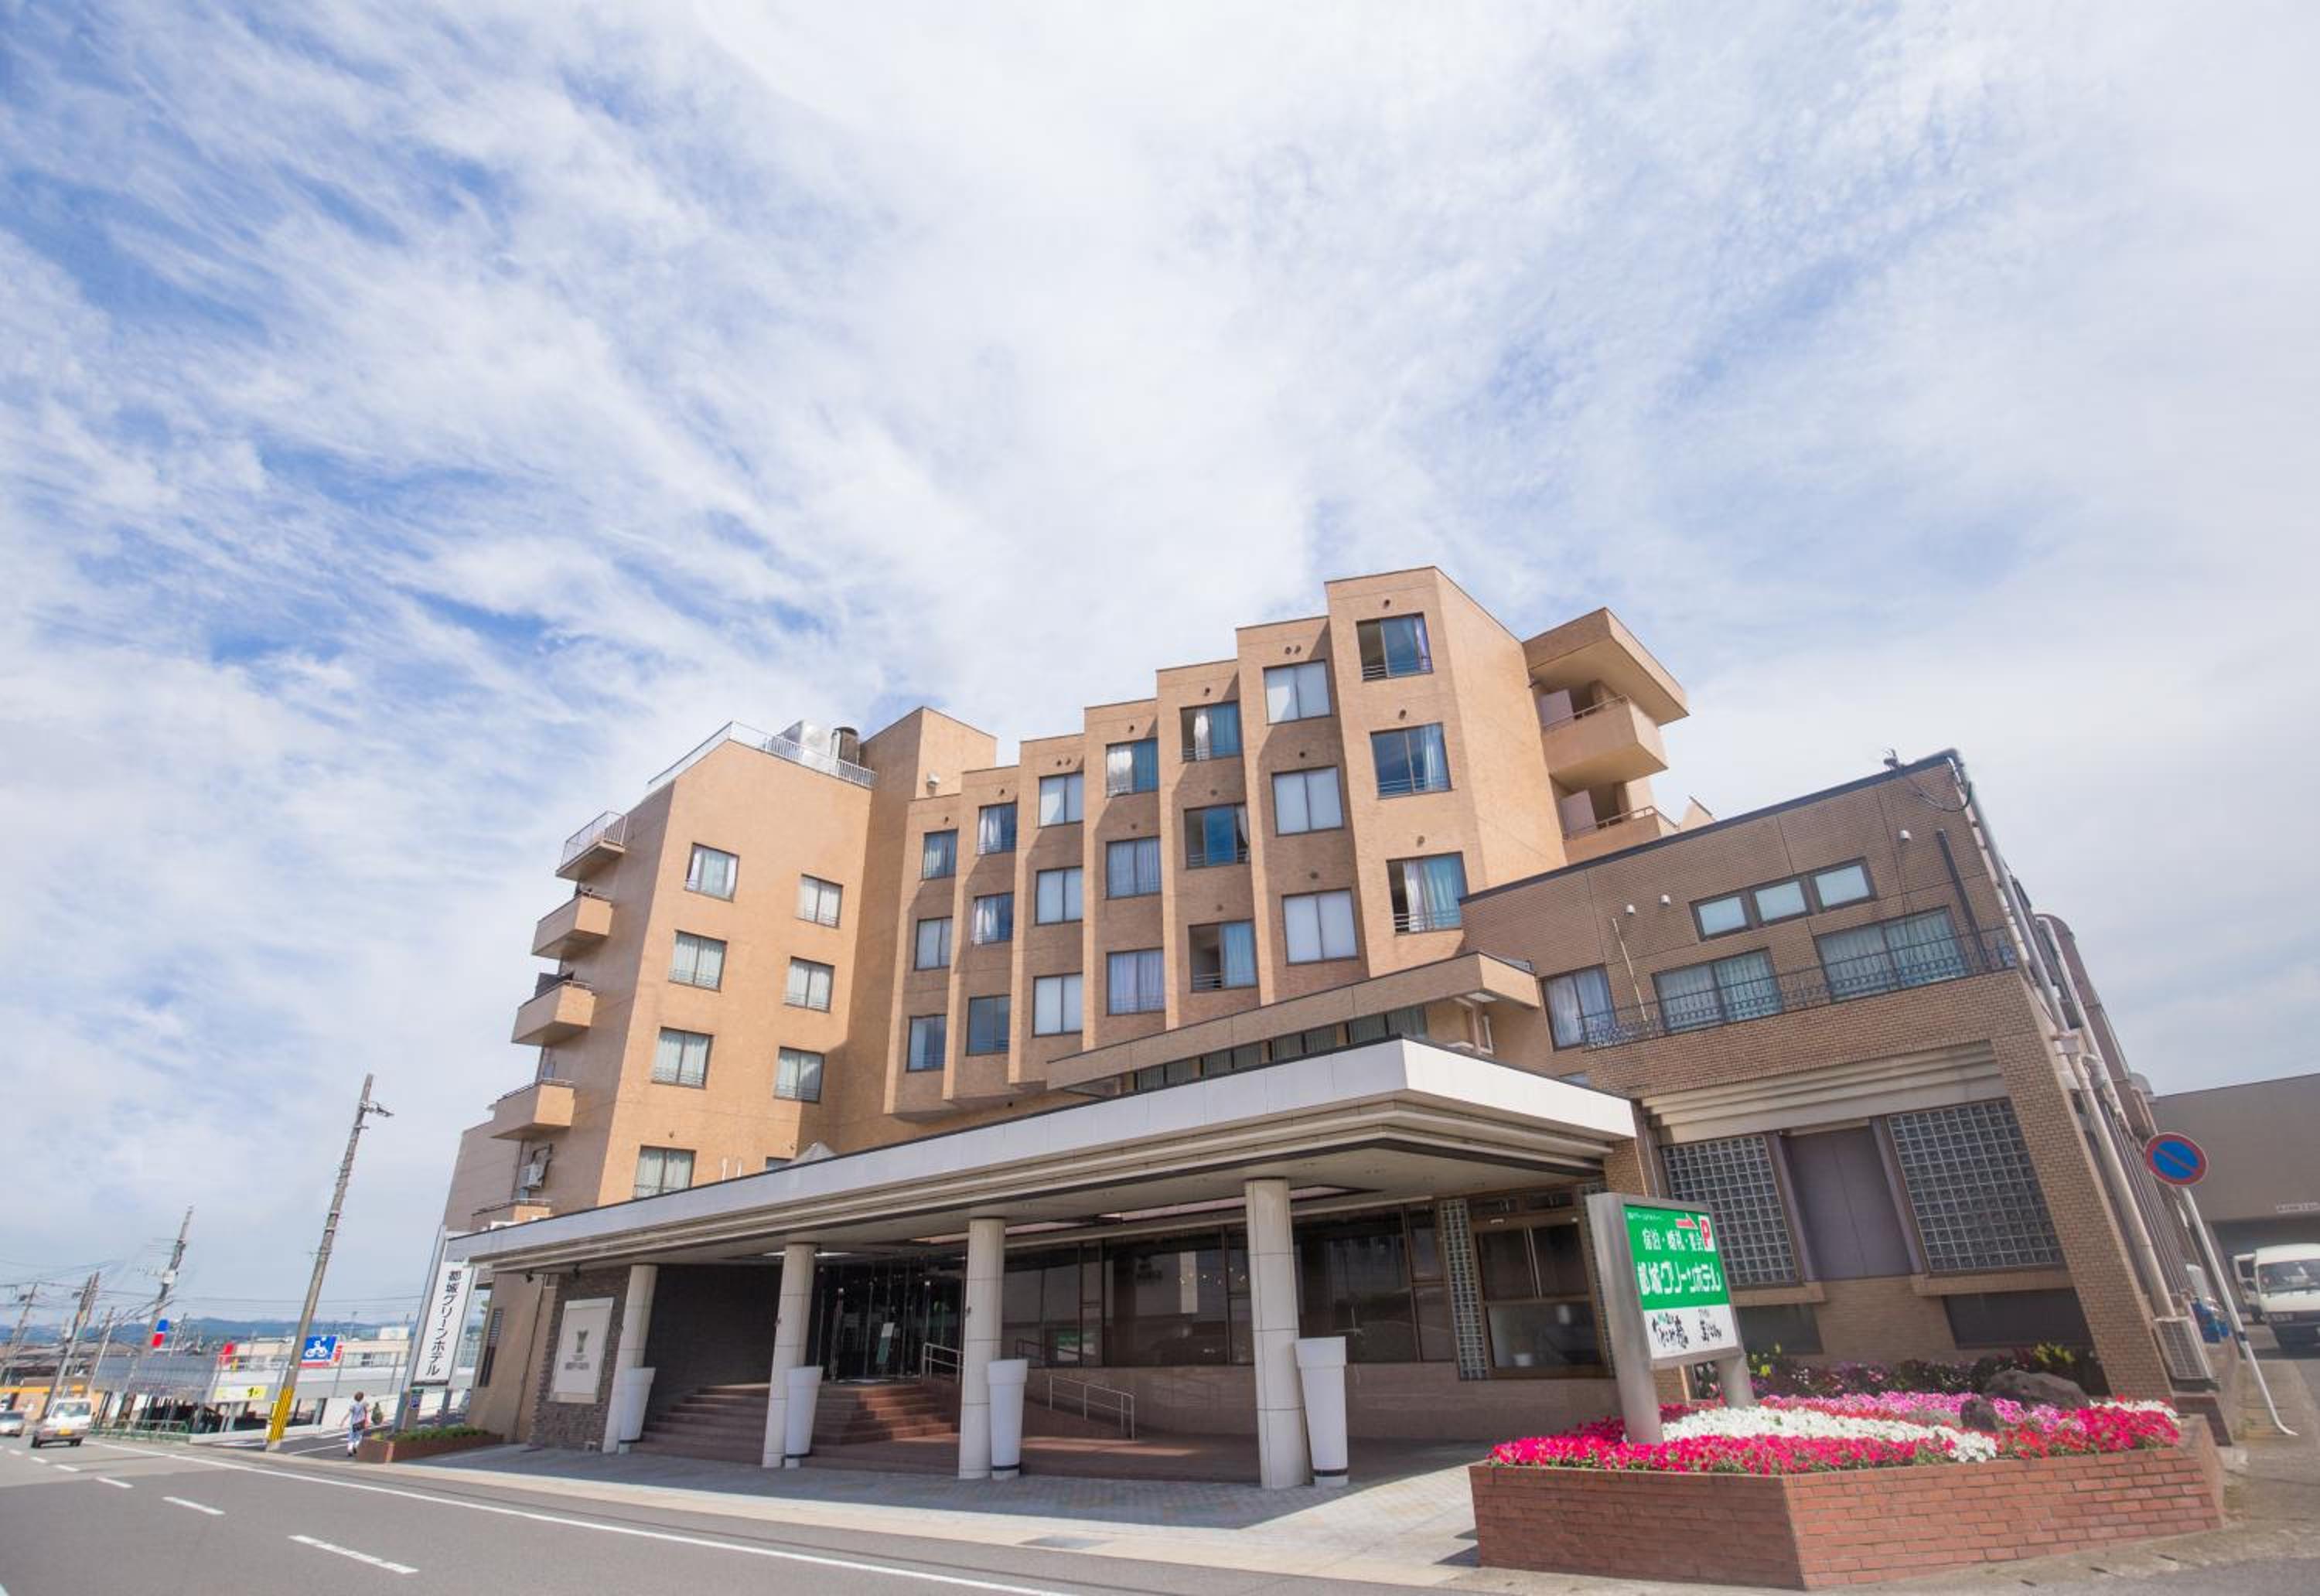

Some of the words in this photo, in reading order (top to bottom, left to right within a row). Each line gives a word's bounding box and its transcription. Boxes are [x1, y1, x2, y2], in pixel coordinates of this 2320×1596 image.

[425, 1270, 462, 1376] 都城グリーンホテル
